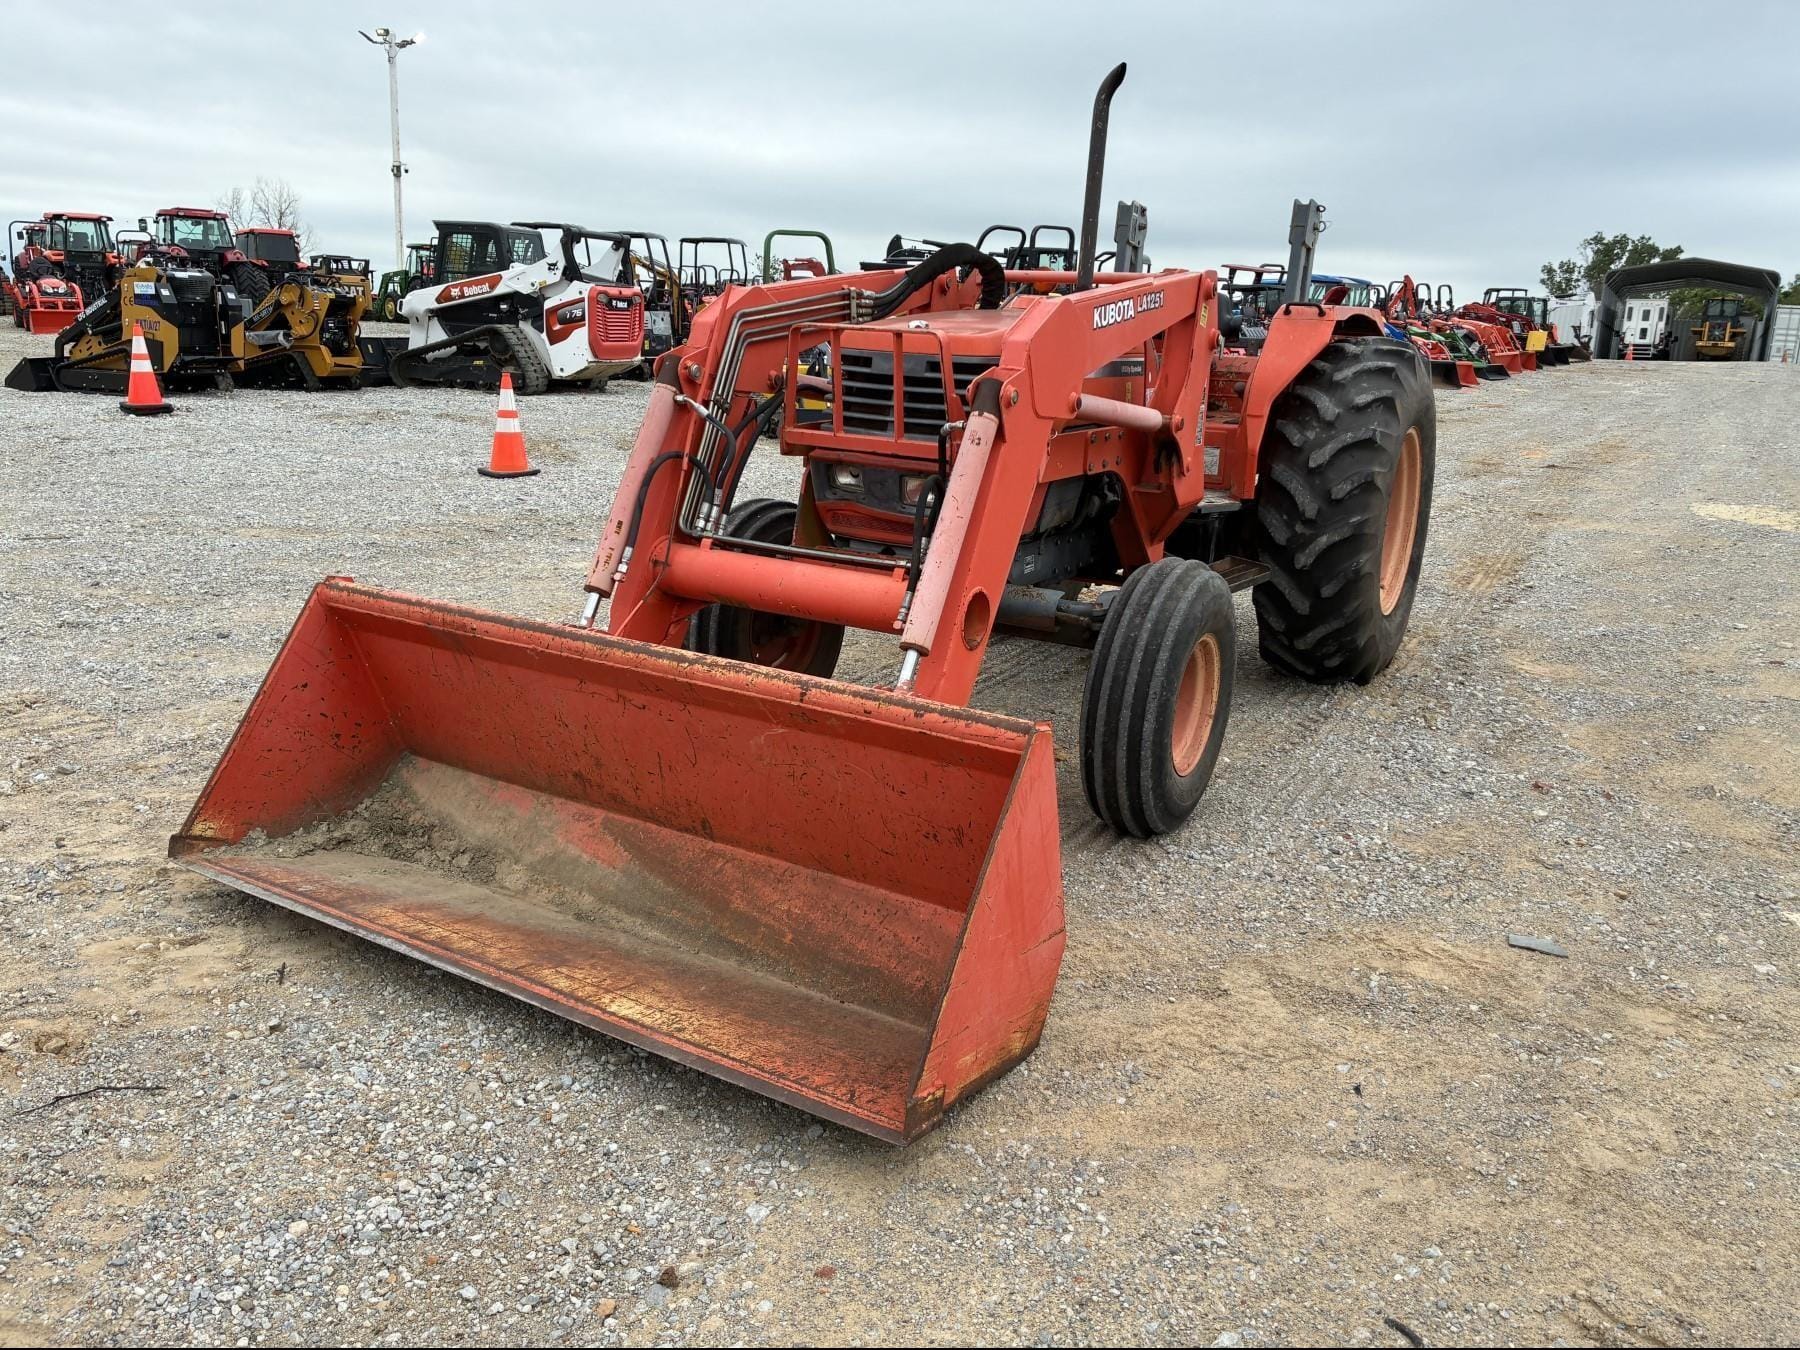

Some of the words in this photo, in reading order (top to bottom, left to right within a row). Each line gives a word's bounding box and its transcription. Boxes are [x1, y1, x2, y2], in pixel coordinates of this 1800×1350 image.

[463, 282, 490, 297] Bobcat
[1093, 298, 1135, 329] KUBOTA
[1137, 290, 1164, 312] LA1251
